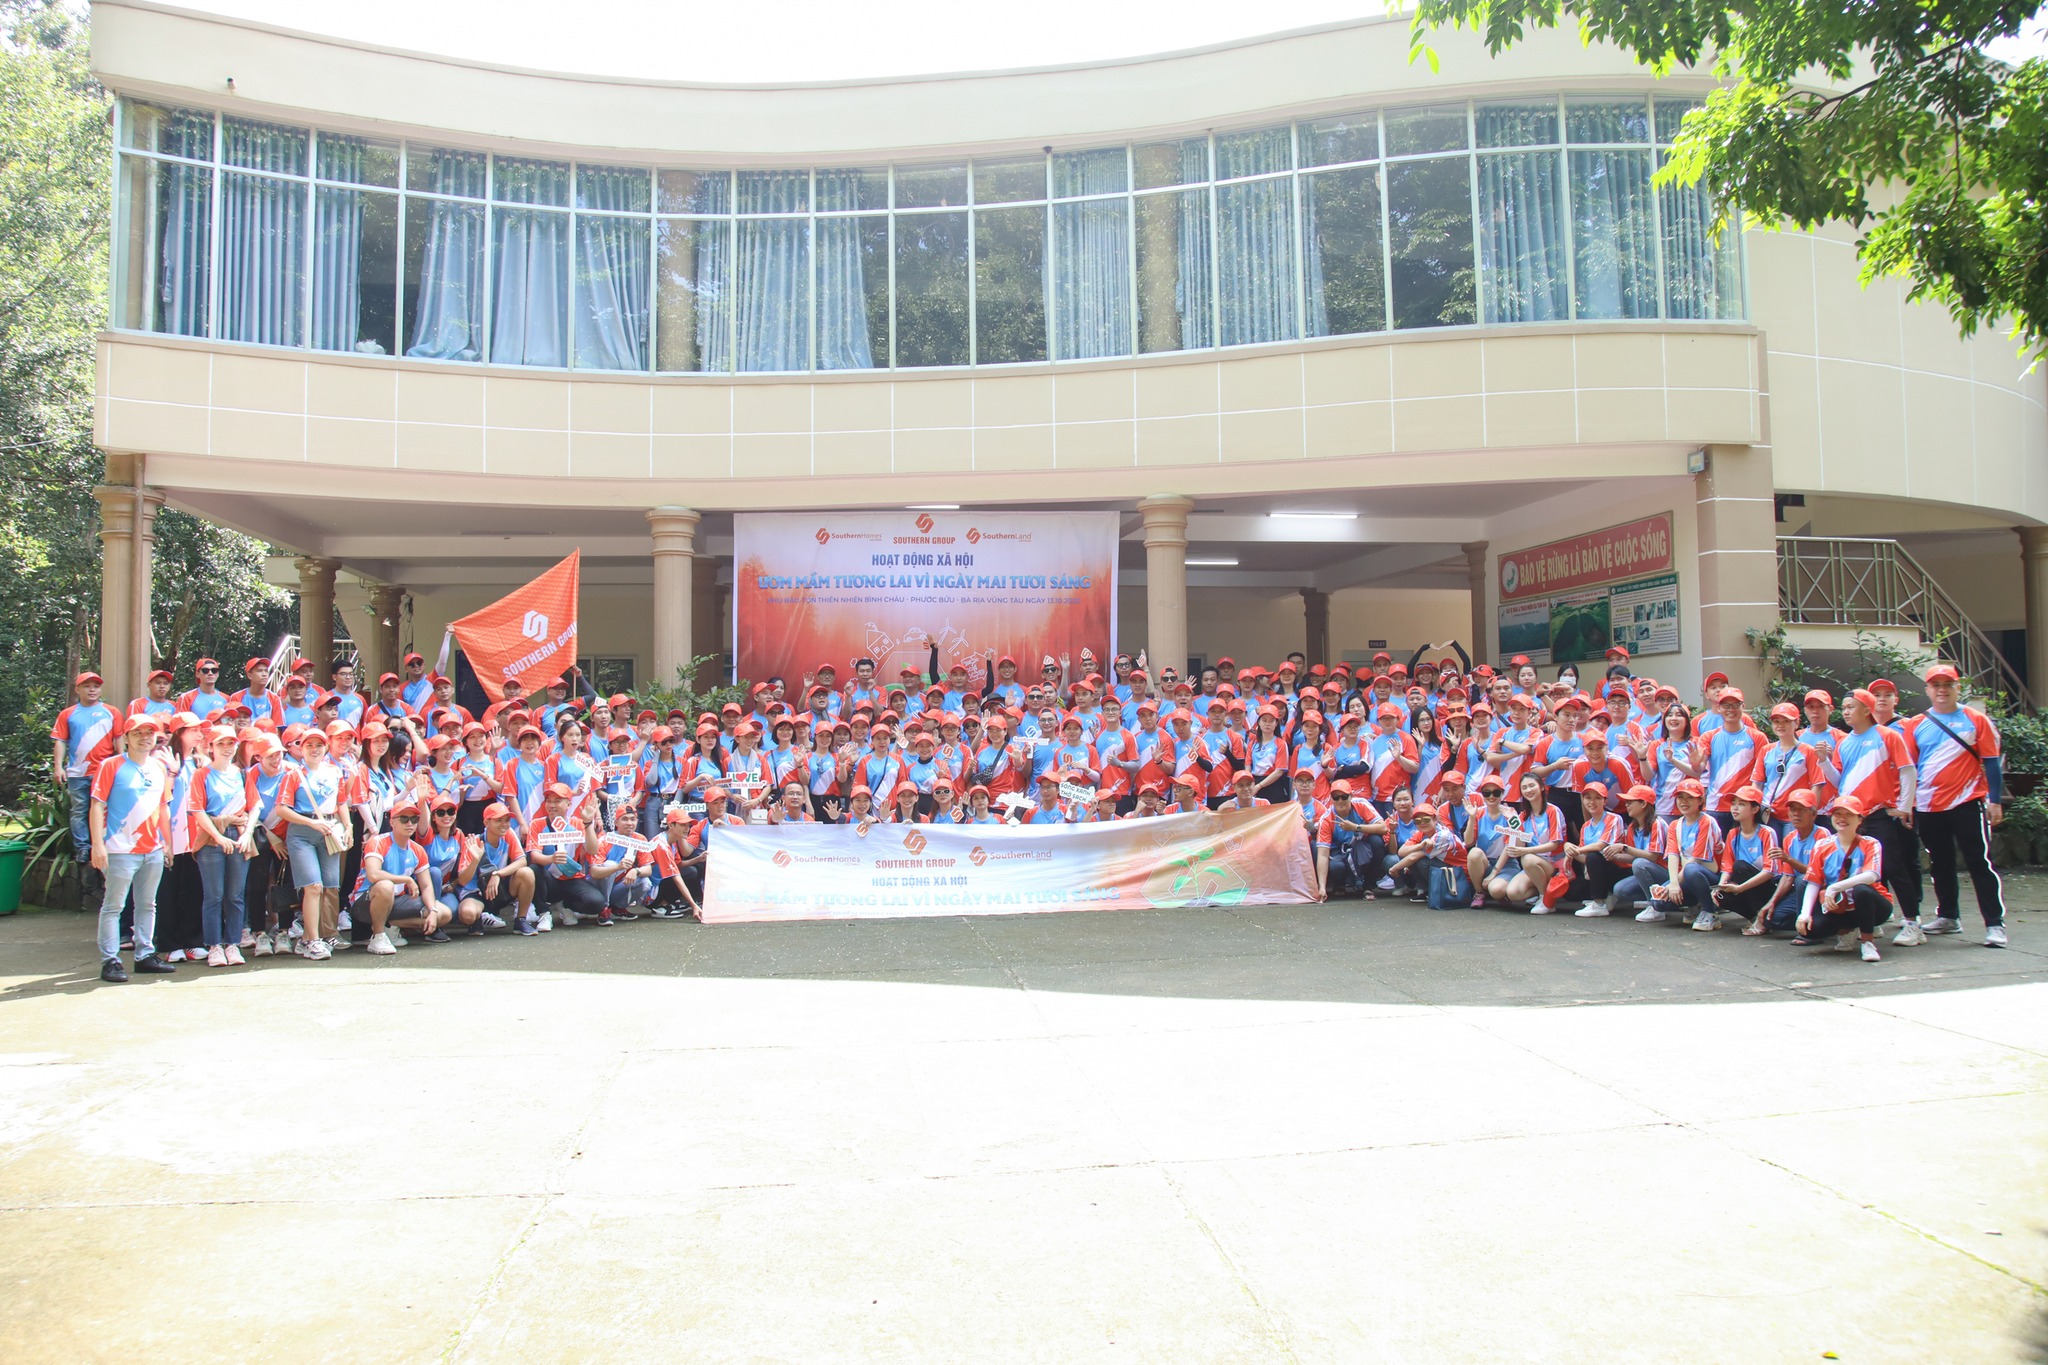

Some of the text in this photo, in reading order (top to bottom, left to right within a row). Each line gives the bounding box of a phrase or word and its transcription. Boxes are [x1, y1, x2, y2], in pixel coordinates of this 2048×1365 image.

[932, 536, 956, 544] GROUP
[982, 532, 1032, 540] SouthernLand
[872, 552, 974, 568] HOẠT ĐỘNG XÃ HỘI
[1519, 522, 1667, 589] BẢO VỆ RỪNG LÀ BẢO VỆ CUỘC SỐNG
[833, 574, 886, 588] TƯƠNG
[889, 575, 912, 588] LAI
[914, 572, 930, 588] VÌ
[933, 572, 975, 588] NGÀY
[977, 575, 1006, 588] MAI
[1009, 574, 1046, 589] TƯƠI
[1049, 573, 1091, 589] SÁNG
[503, 641, 558, 678] SOUTHERN
[619, 767, 631, 776] ME
[794, 855, 861, 863] SouthernHomes
[990, 849, 1052, 860] SouthernLand
[875, 858, 956, 869] SOUTHERN GROUP
[987, 891, 1021, 905] MAI
